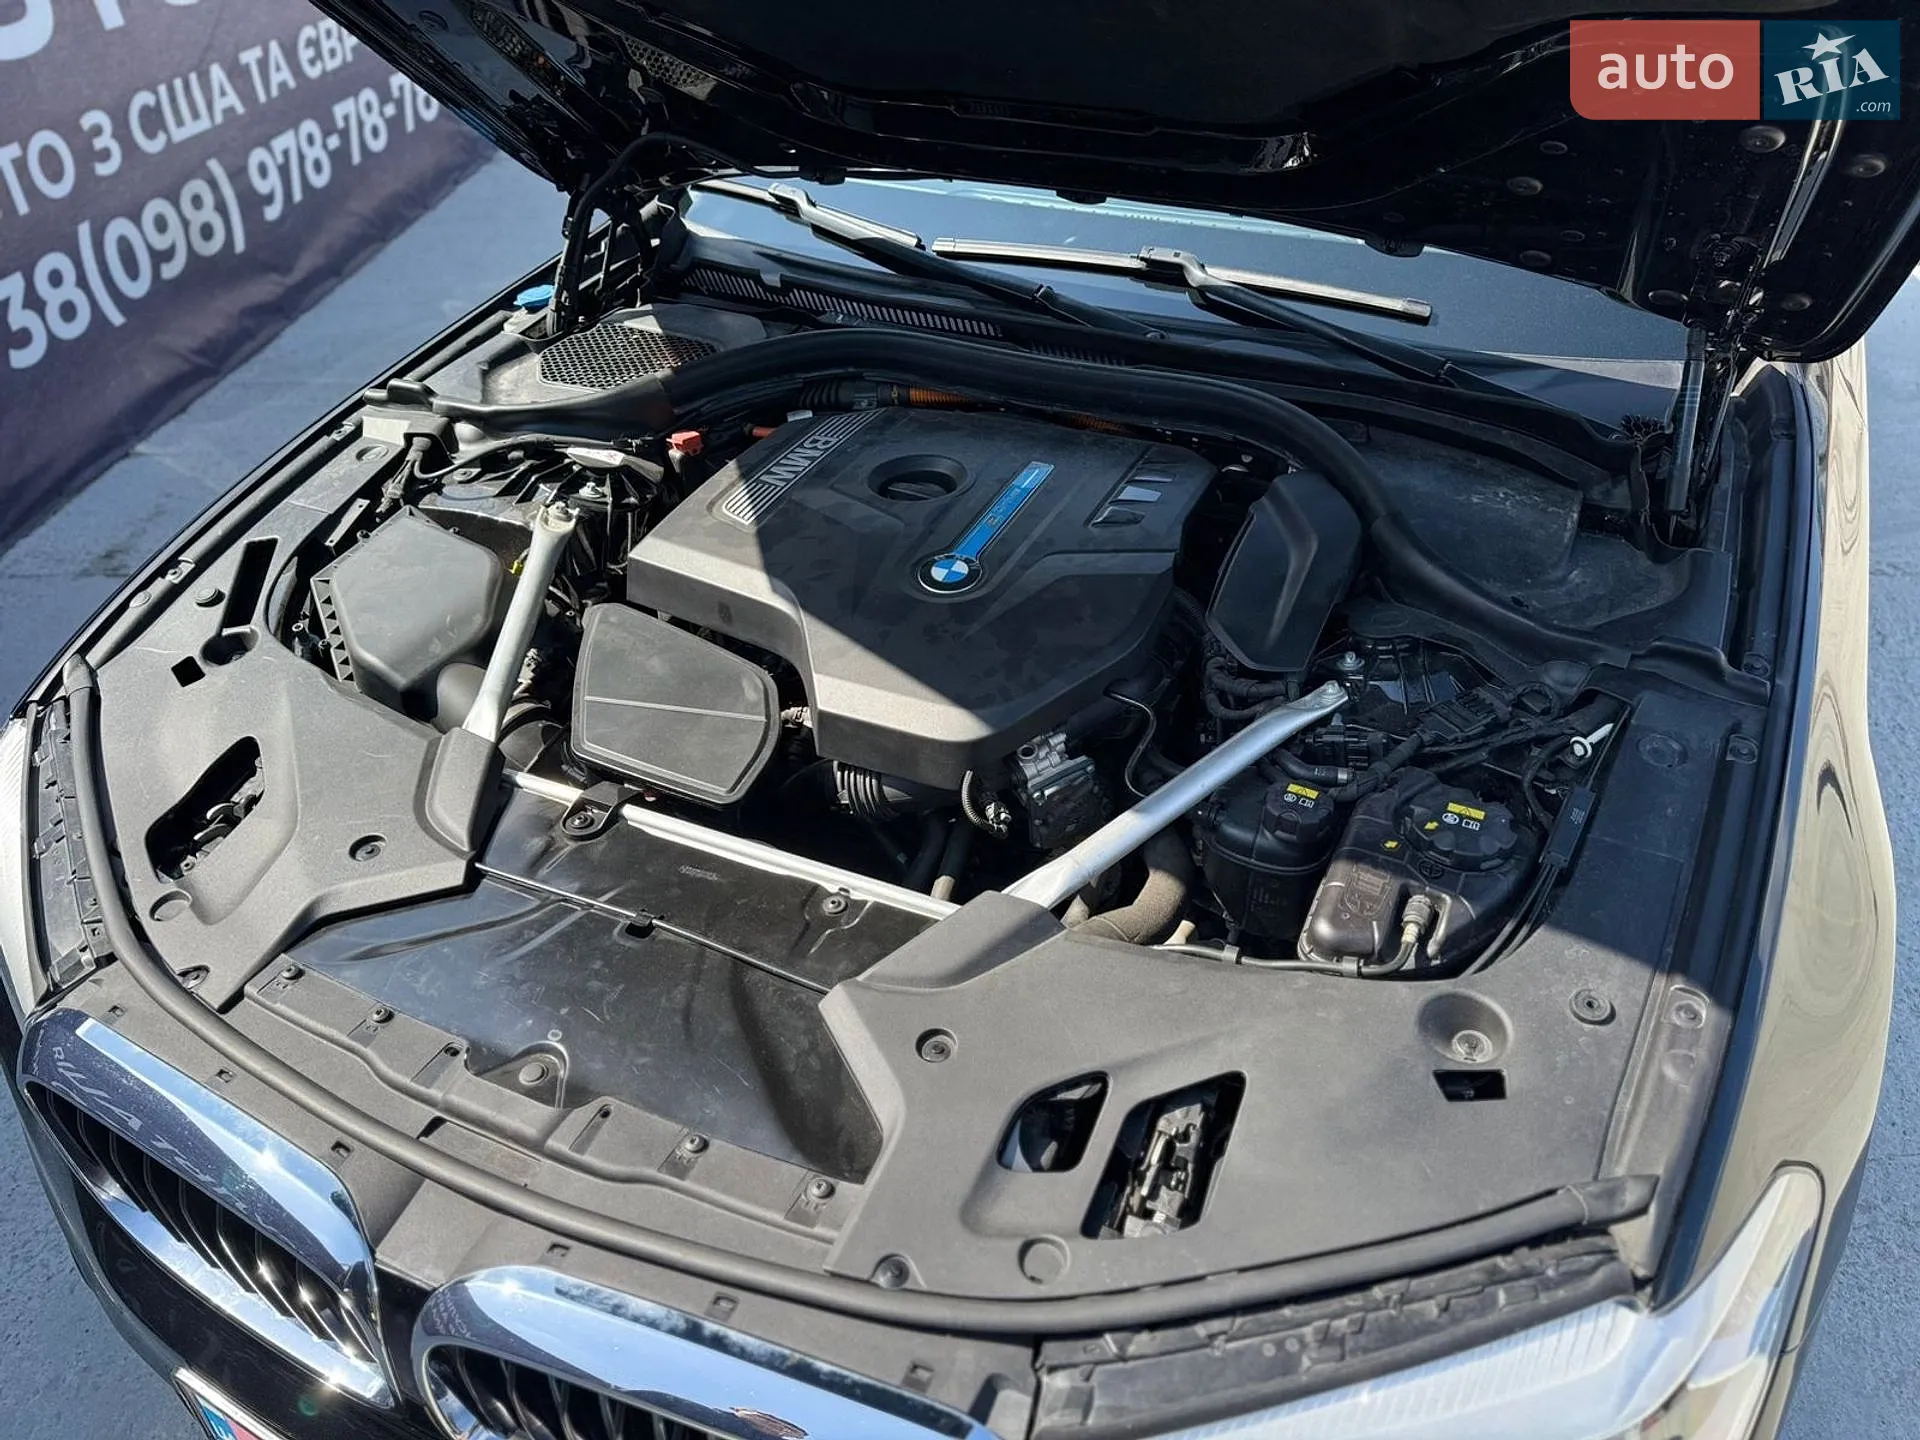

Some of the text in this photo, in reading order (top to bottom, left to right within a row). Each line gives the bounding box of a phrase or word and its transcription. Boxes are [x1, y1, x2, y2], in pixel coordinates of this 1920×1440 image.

[128, 61, 246, 154] США
[237, 38, 297, 104] ТА
[759, 435, 840, 488] BMW
